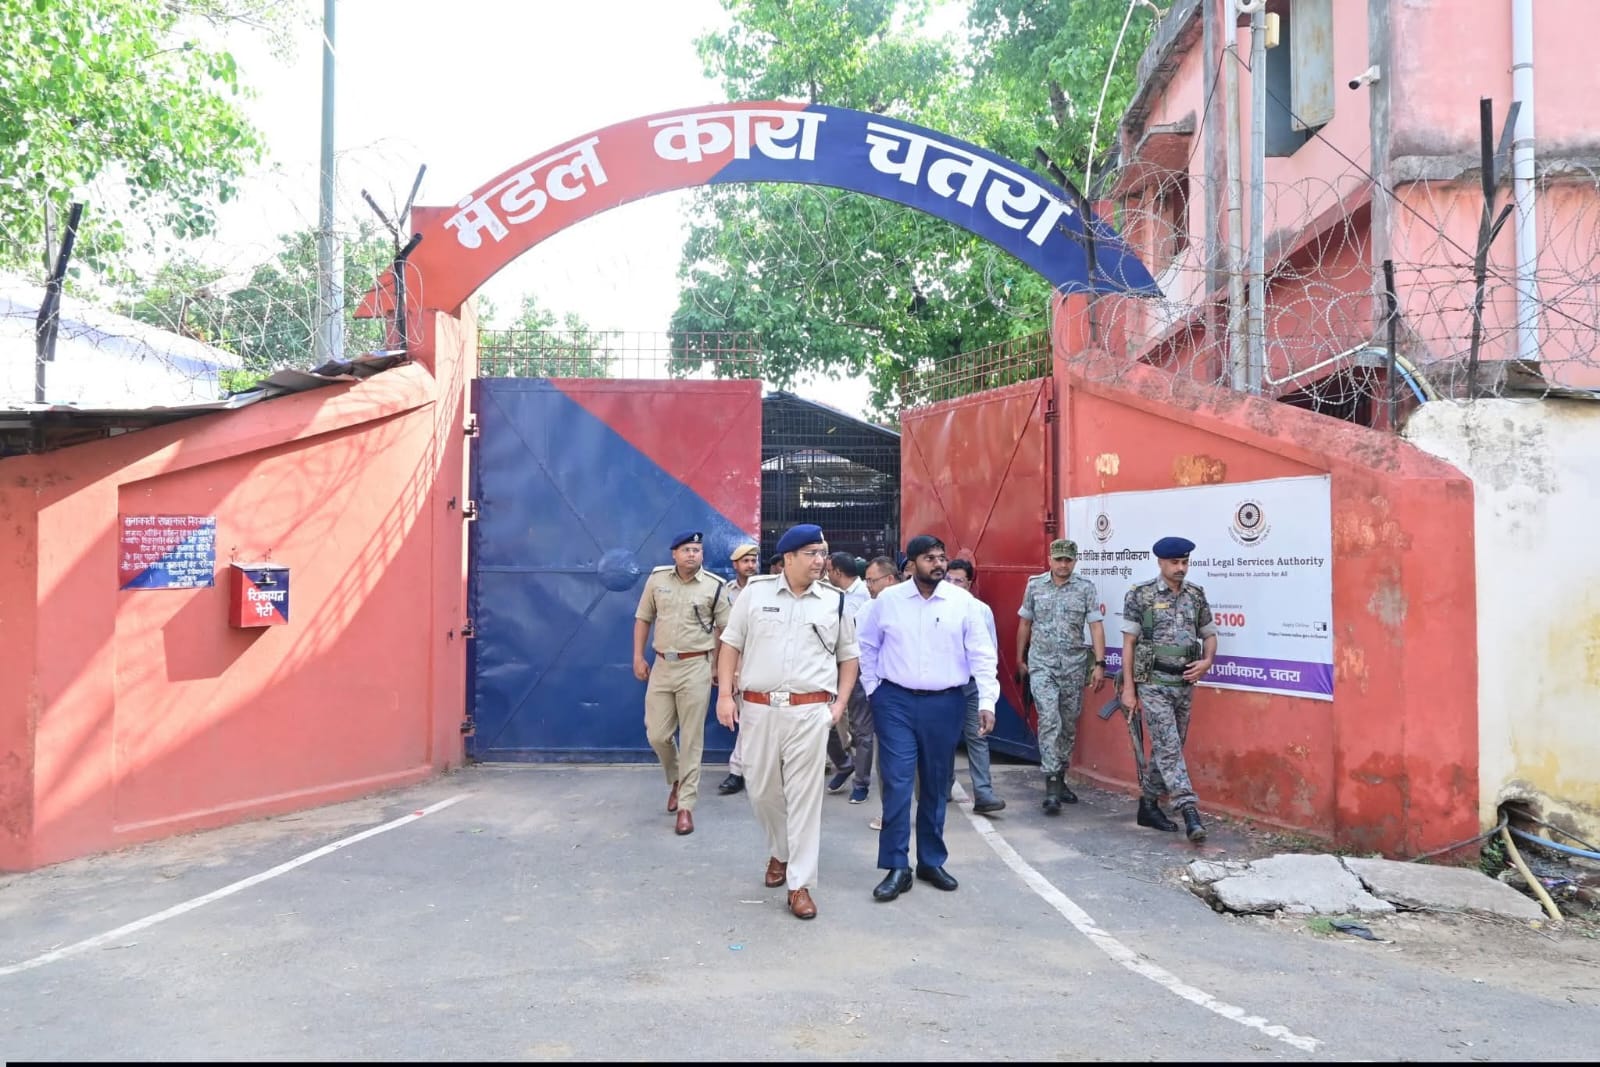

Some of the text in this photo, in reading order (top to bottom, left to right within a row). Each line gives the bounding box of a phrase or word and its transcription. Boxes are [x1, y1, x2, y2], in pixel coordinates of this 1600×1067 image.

[443, 109, 1074, 250] मंडल कारा चतरा
[1101, 549, 1114, 561] सेवा
[1115, 549, 1150, 561] प्राधिकरण
[1189, 556, 1324, 568] ional Legal Services Authority
[247, 587, 287, 601] शिकायत
[255, 602, 275, 617] पेटी
[1214, 612, 1245, 627] 5100
[1104, 652, 1122, 666] सचि
[1216, 661, 1268, 681] प्राधिकार,
[1269, 668, 1301, 683] चतरा
